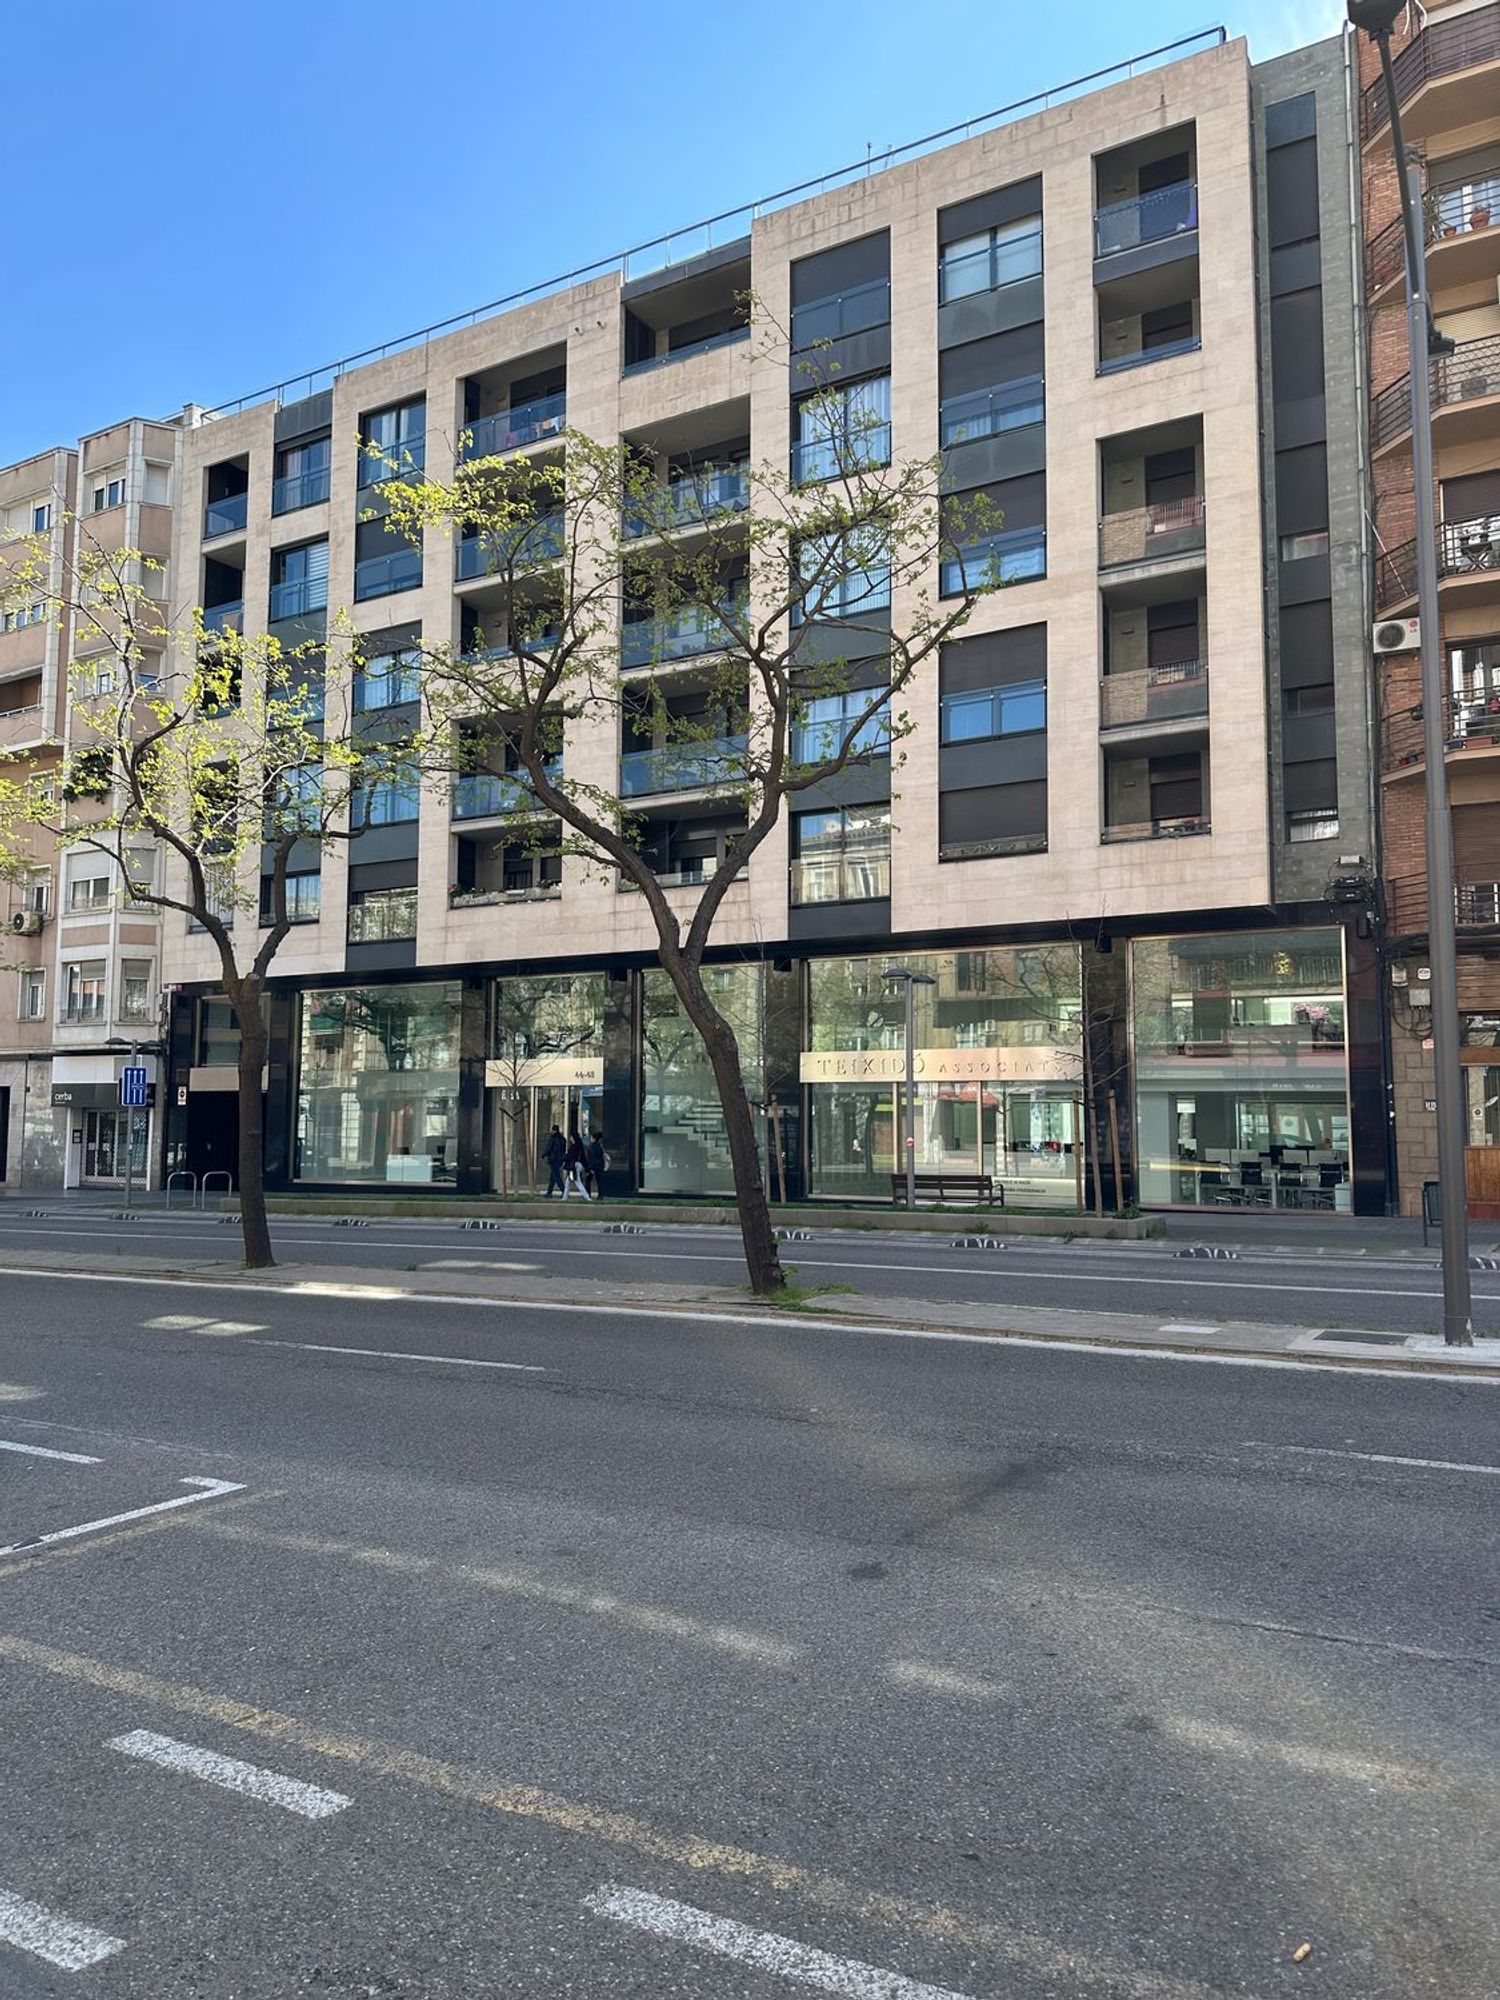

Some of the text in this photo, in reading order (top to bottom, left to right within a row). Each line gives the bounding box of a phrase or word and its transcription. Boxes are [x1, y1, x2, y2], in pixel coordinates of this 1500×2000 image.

[817, 1053, 1063, 1075] TEIXIDÓ ASSOCIATS
[54, 1091, 72, 1101] cerba
